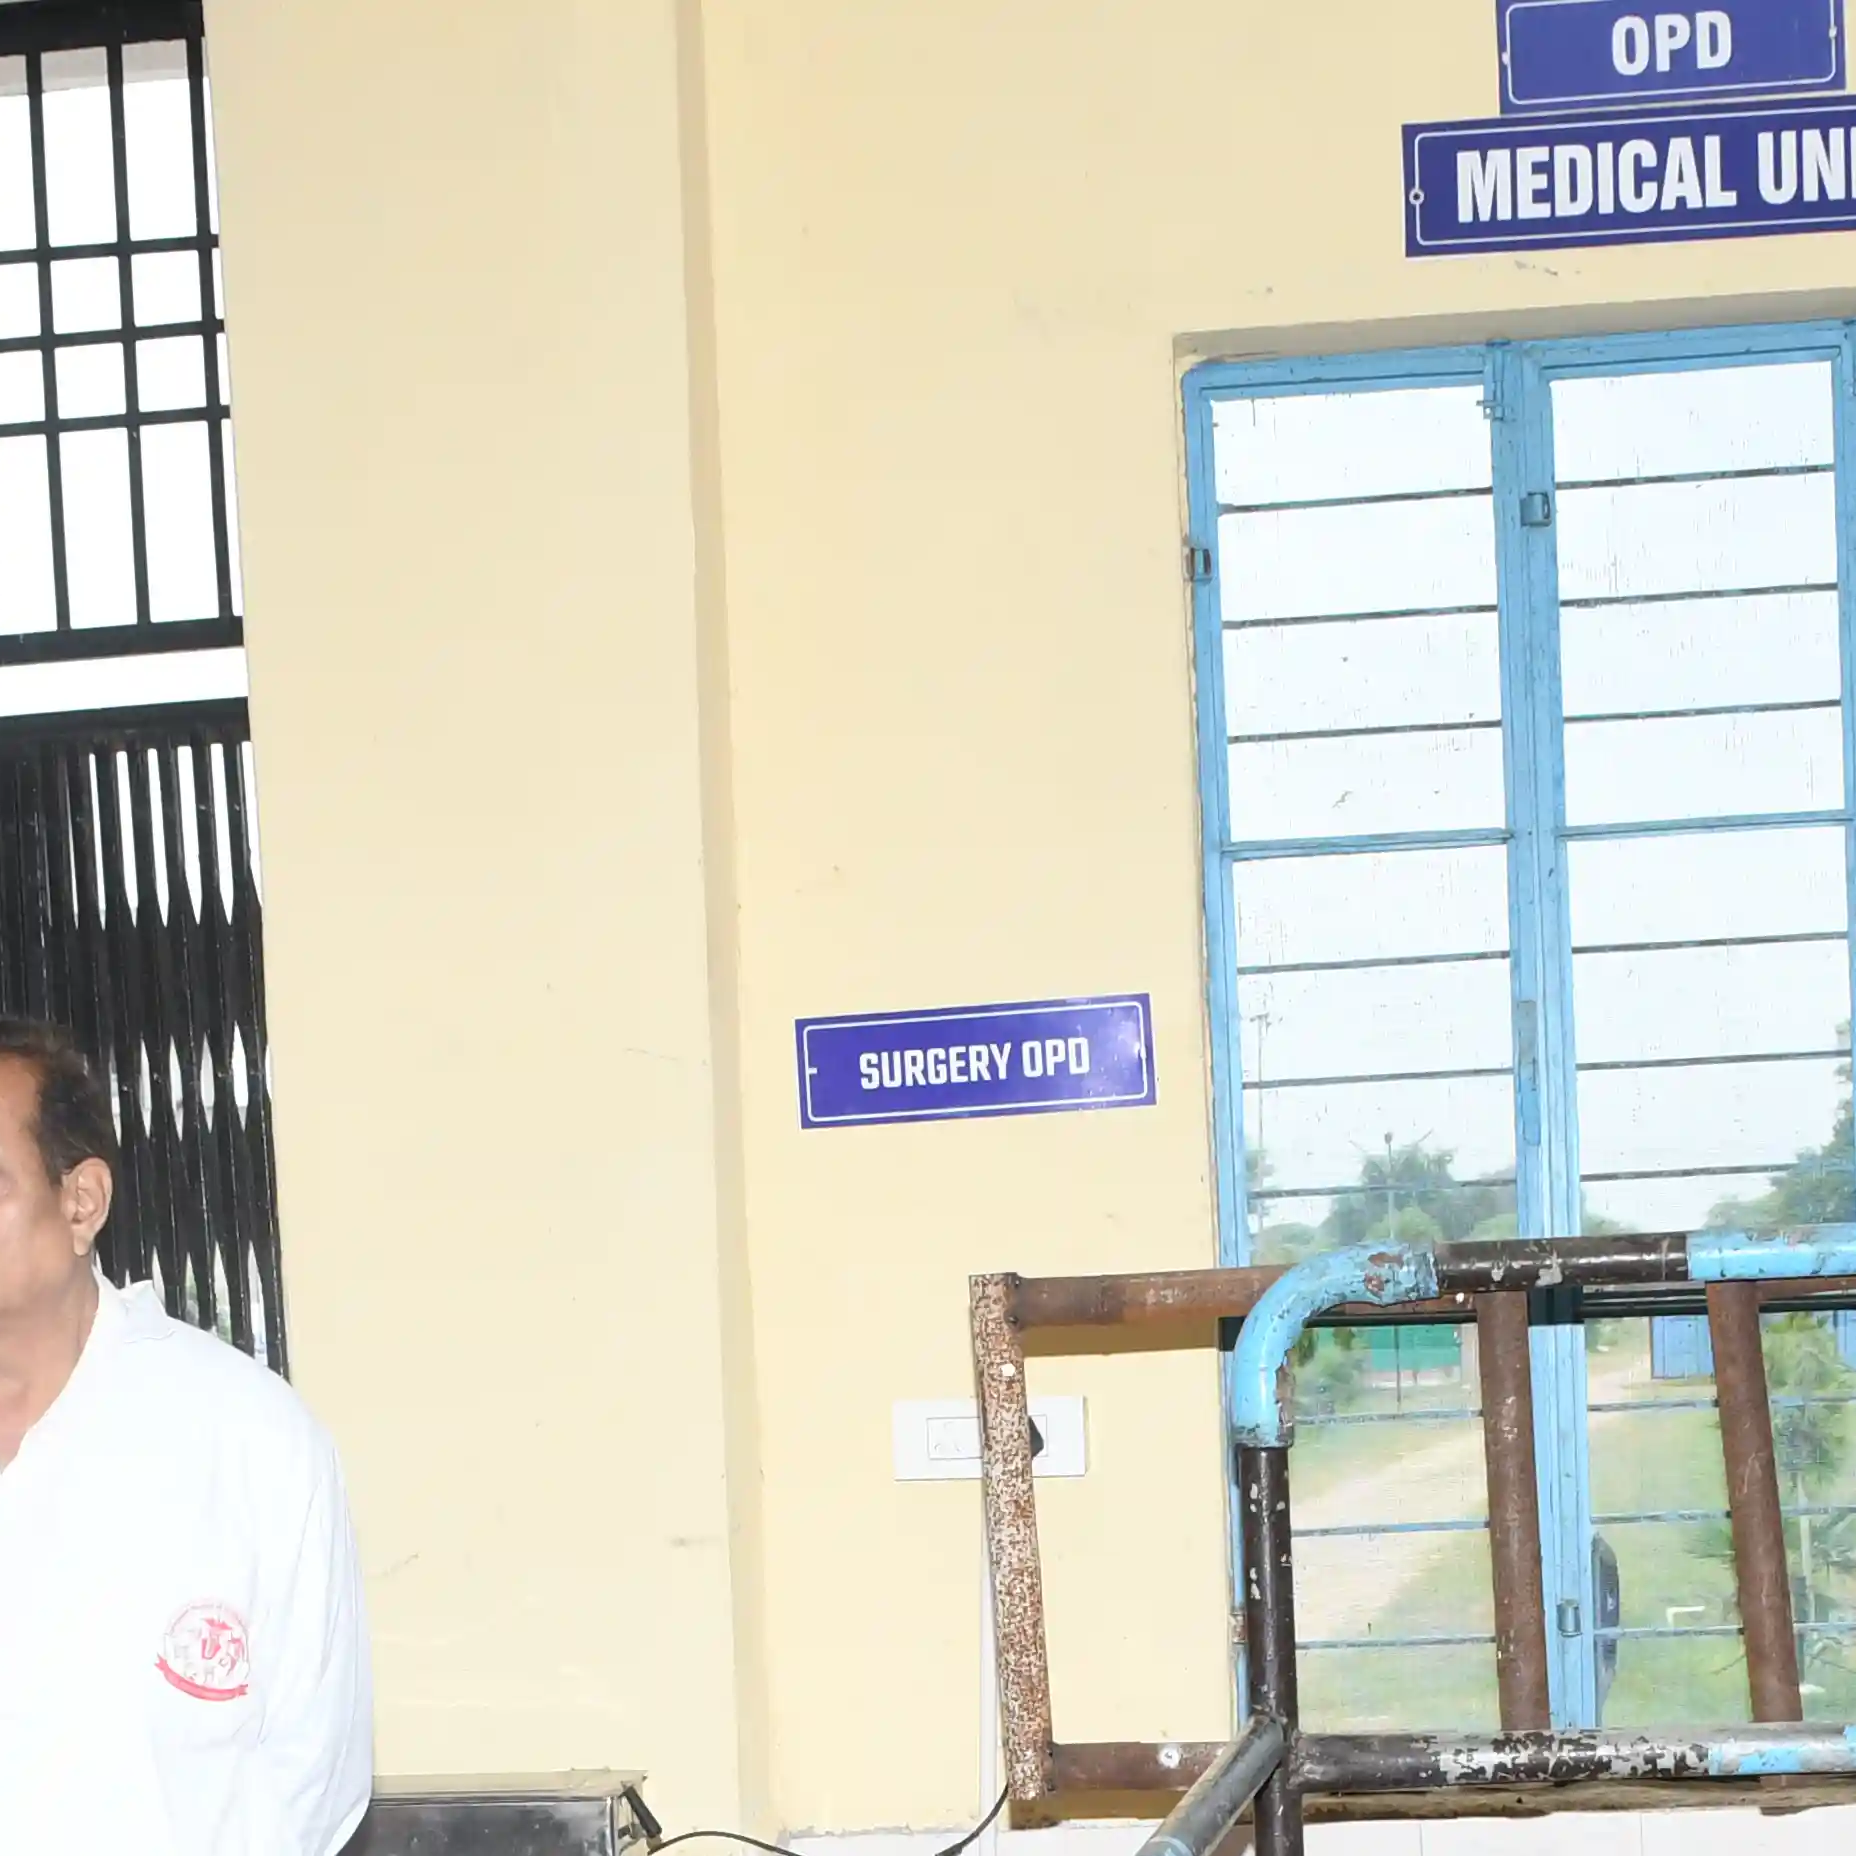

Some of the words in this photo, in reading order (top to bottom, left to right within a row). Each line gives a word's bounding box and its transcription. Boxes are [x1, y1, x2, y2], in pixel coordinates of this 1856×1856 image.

[1612, 10, 1733, 76] OPD
[1456, 135, 1737, 224] MEDICAL
[859, 1041, 1012, 1090] SURGERY
[1022, 1036, 1090, 1079] OPD
